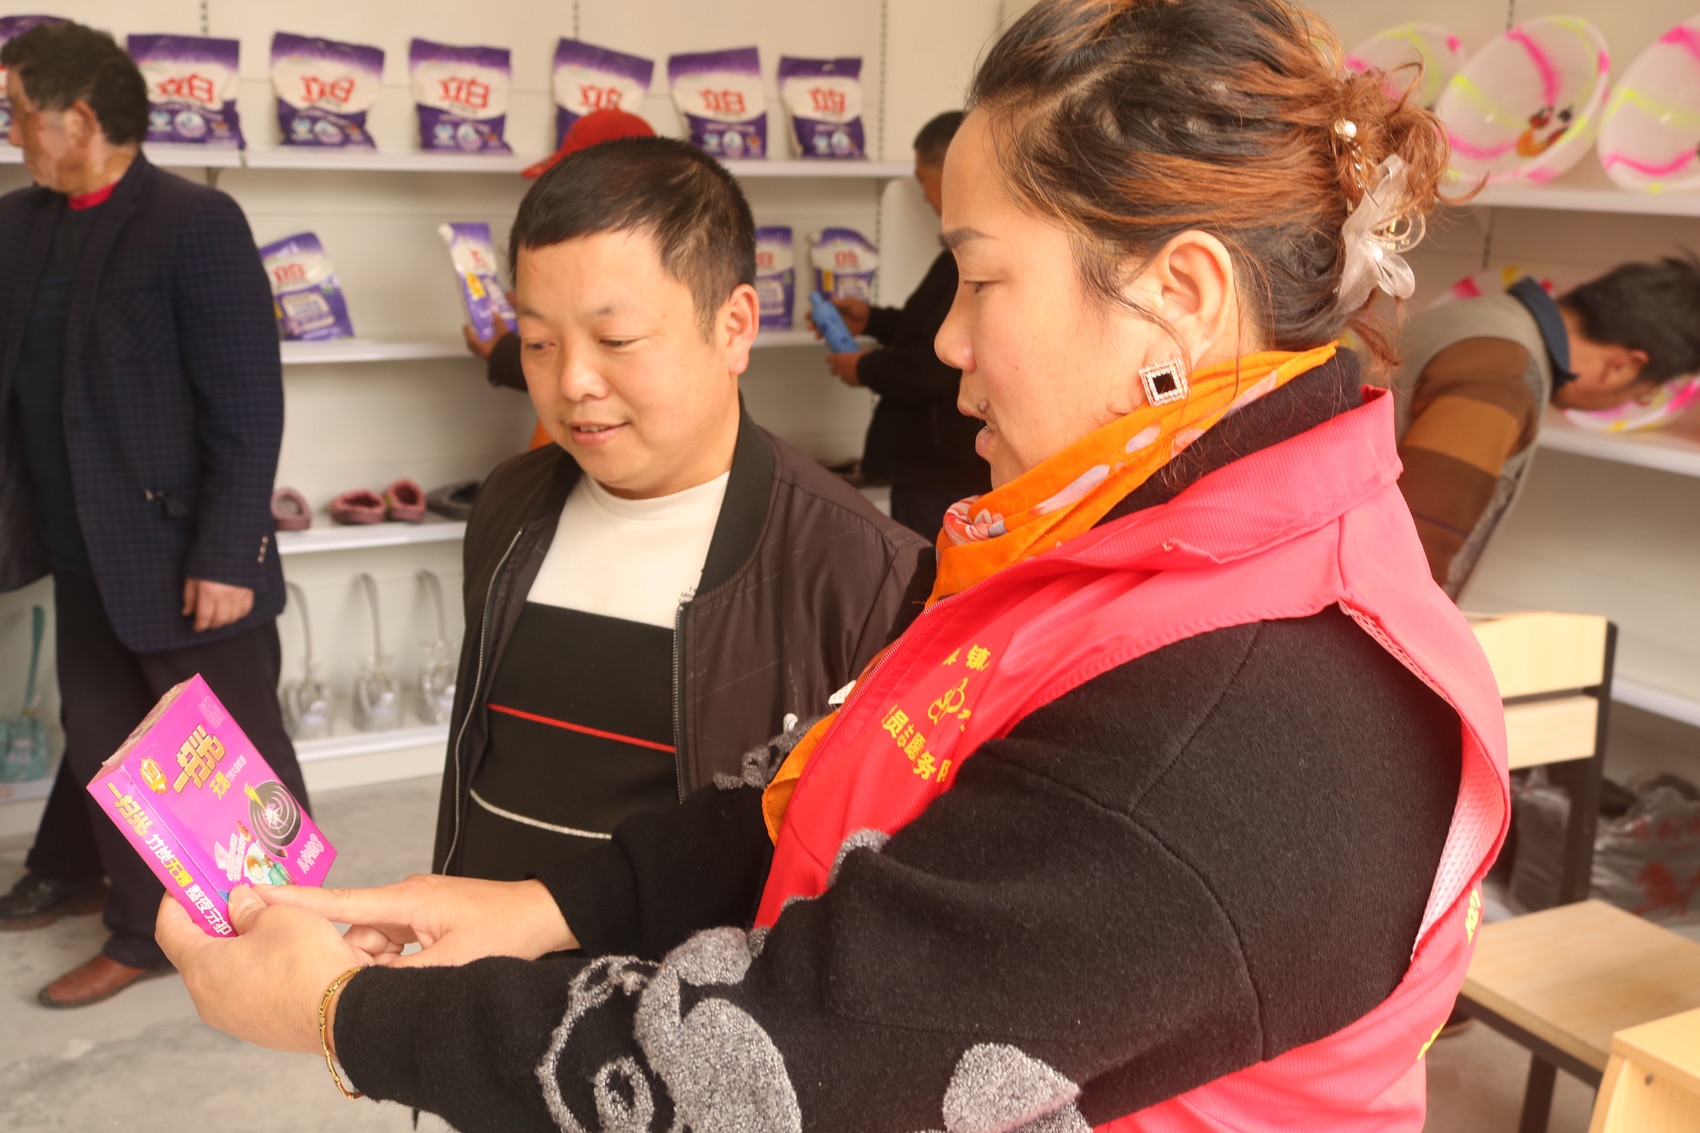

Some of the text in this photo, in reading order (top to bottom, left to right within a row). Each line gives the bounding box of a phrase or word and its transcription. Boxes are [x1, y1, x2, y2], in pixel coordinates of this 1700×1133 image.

[300, 75, 356, 104] 立白
[438, 76, 490, 109] 立白
[699, 87, 746, 114] 立白
[807, 86, 846, 115] 立白
[172, 723, 226, 795] 一扫光
[209, 770, 231, 801] 无烟
[106, 781, 153, 837] 一扫光
[144, 833, 194, 888] 竹炭无烟
[184, 883, 233, 936] 整夜守护
